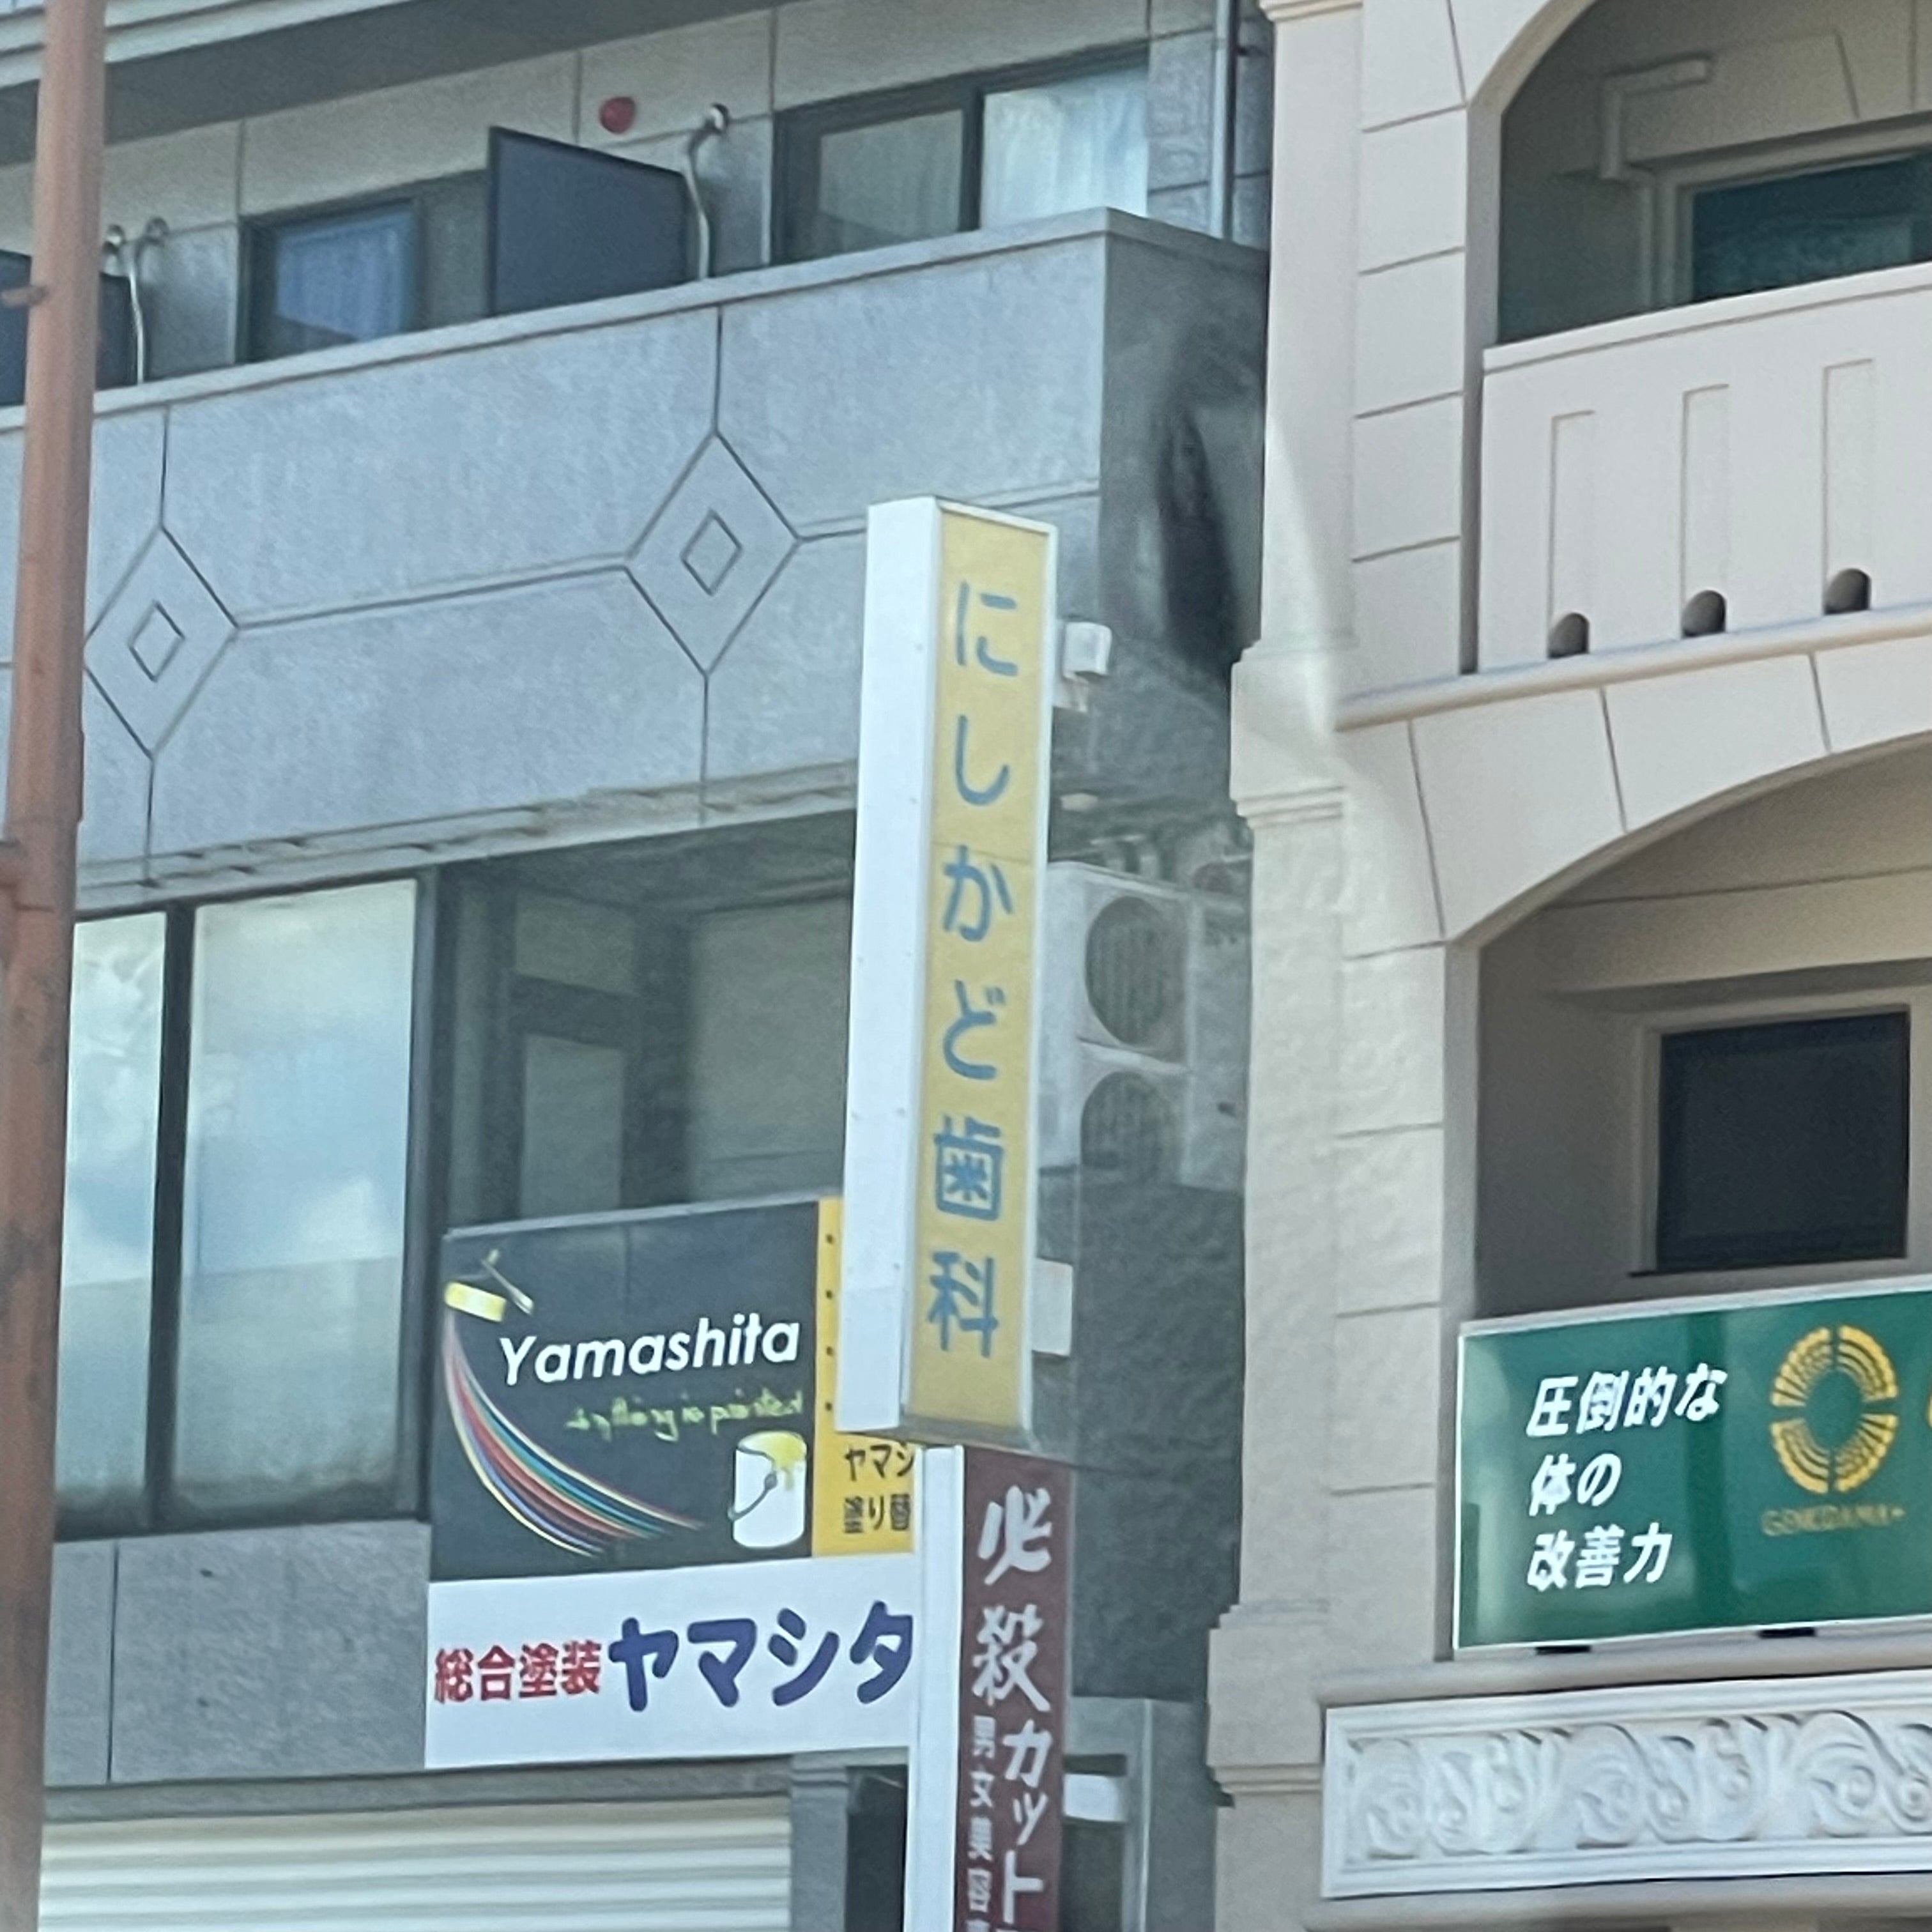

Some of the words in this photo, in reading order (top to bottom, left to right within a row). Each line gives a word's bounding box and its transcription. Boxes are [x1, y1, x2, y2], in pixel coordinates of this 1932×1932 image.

[926, 581, 1020, 1358] にしかど歯科
[500, 1313, 801, 1386] Yamashita
[1526, 1362, 1728, 1438] 圧倒的な
[1528, 1452, 1621, 1516] 体の
[1526, 1522, 1673, 1591] 改善力
[433, 1639, 602, 1705] 総合塗装
[608, 1600, 914, 1712] ヤマシタ
[972, 1485, 1052, 1932] 必殺カット
